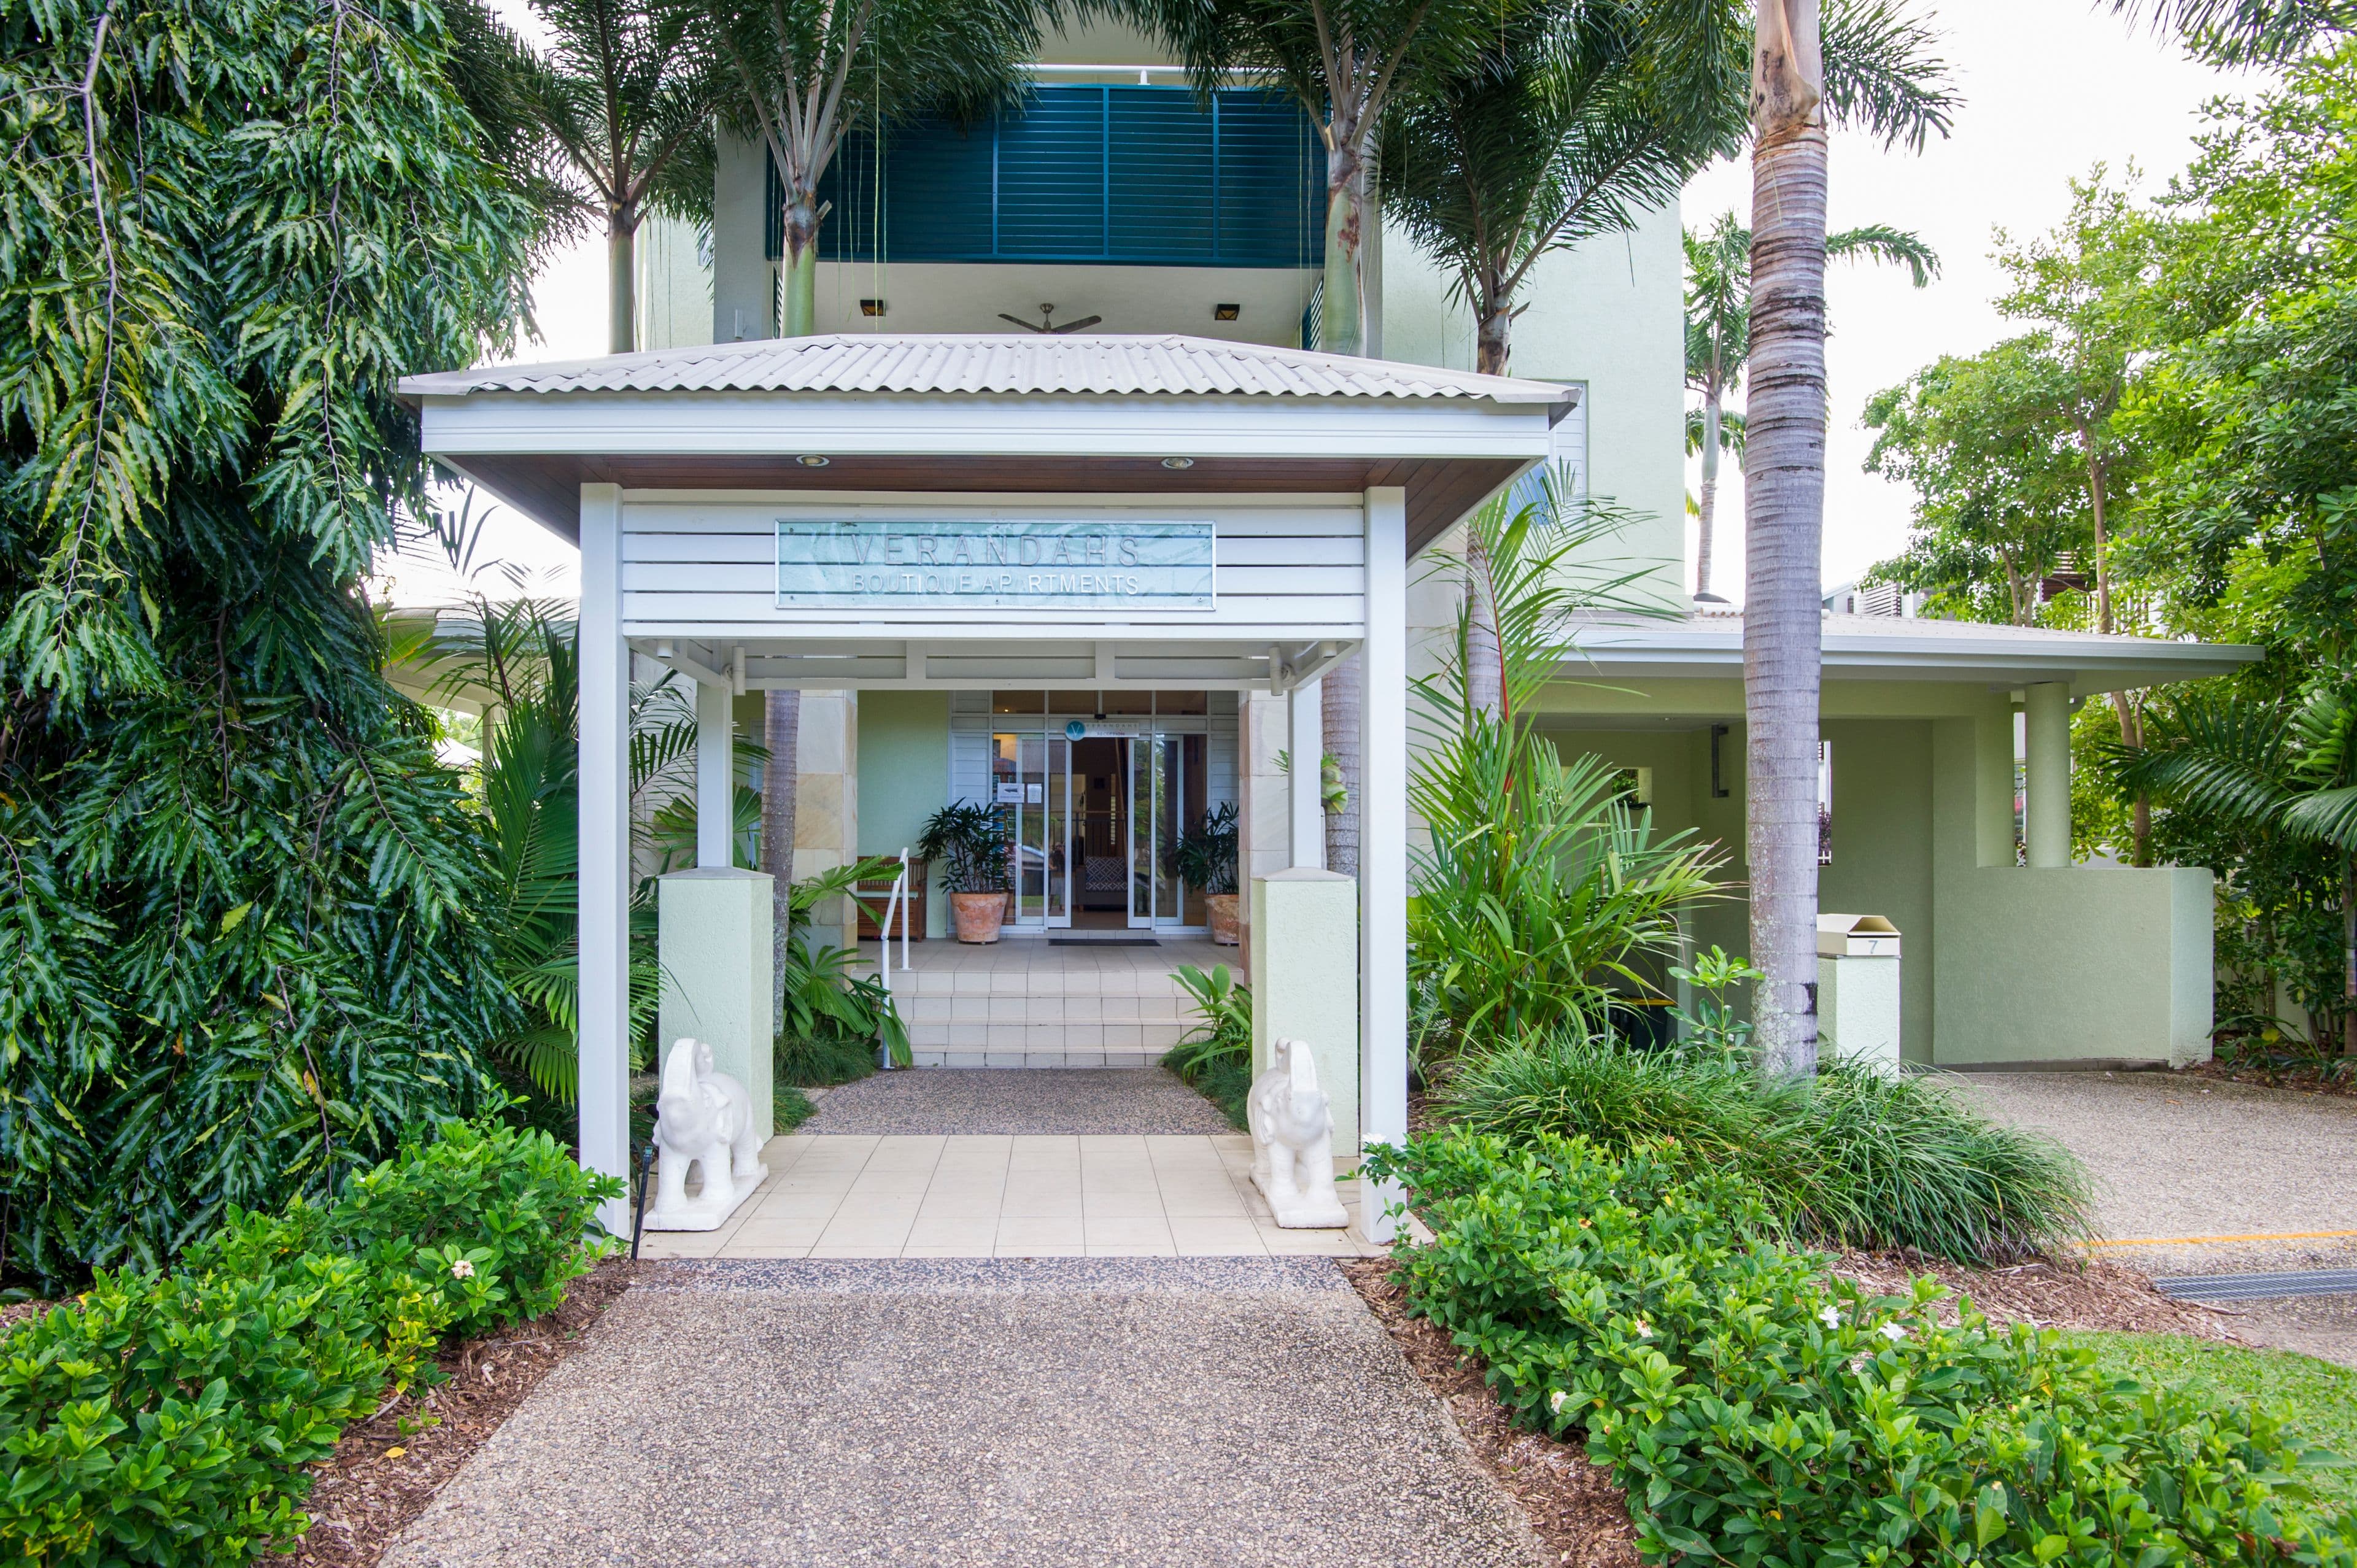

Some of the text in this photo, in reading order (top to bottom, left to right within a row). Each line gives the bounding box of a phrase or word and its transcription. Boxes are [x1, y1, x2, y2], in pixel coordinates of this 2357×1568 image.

[851, 535, 1138, 566] VERANDAHS
[853, 574, 1139, 595] BOUTIQUE APRTMENTS
[1868, 940, 1878, 954] 7
